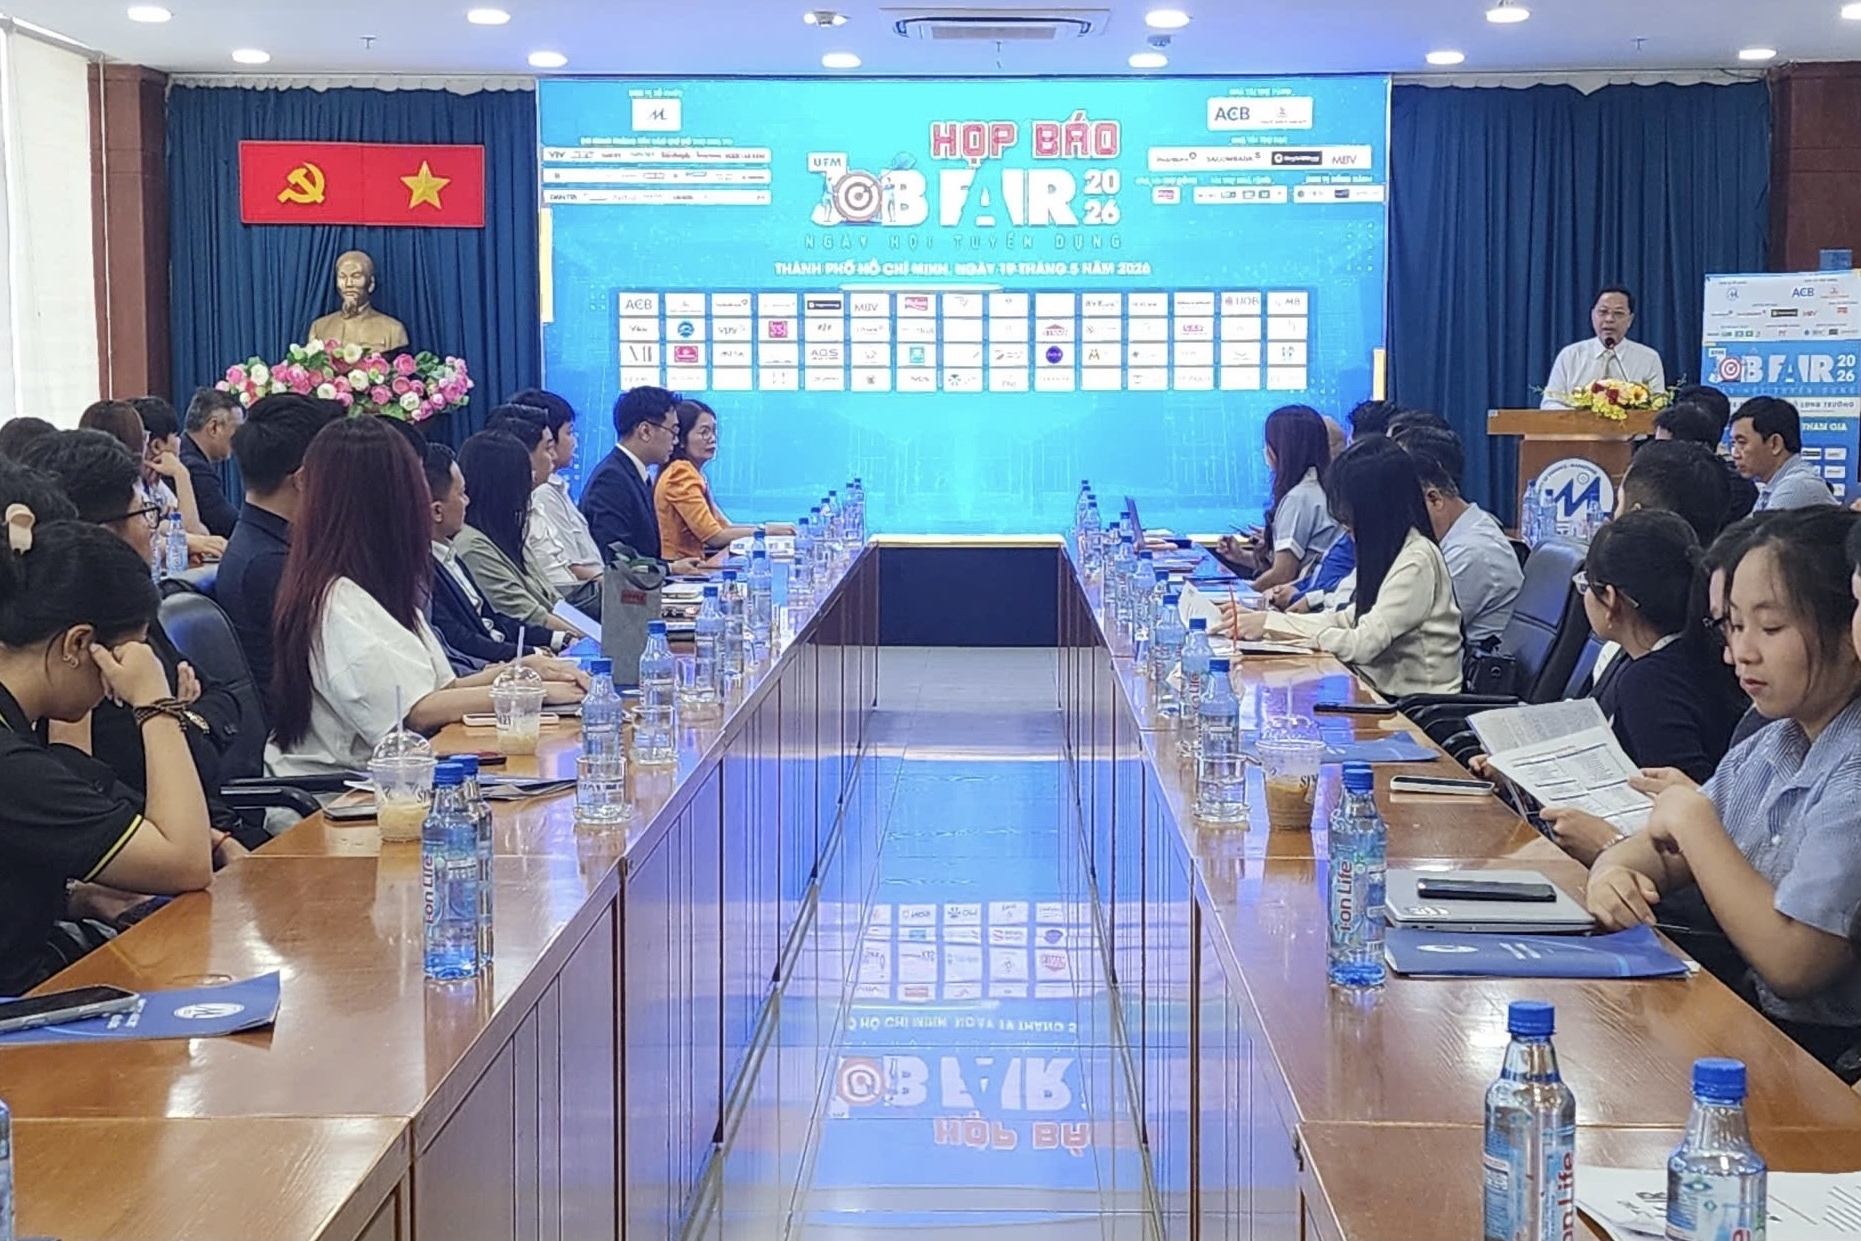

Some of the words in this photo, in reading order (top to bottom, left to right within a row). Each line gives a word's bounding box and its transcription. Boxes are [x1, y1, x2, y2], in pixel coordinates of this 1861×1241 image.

[1214, 106, 1251, 121] ACB
[931, 121, 1017, 166] HỌP
[1034, 111, 1120, 158] BÁO
[813, 157, 842, 168] UFM
[1084, 168, 1121, 195] 20
[940, 168, 1079, 227] FAIR
[1083, 198, 1121, 226] 26
[1792, 287, 1815, 298] ACB
[625, 299, 653, 310] ACB
[1768, 354, 1834, 383] FAIR
[1837, 354, 1856, 367] 20
[1837, 370, 1855, 382] 26
[1336, 860, 1352, 895] Life
